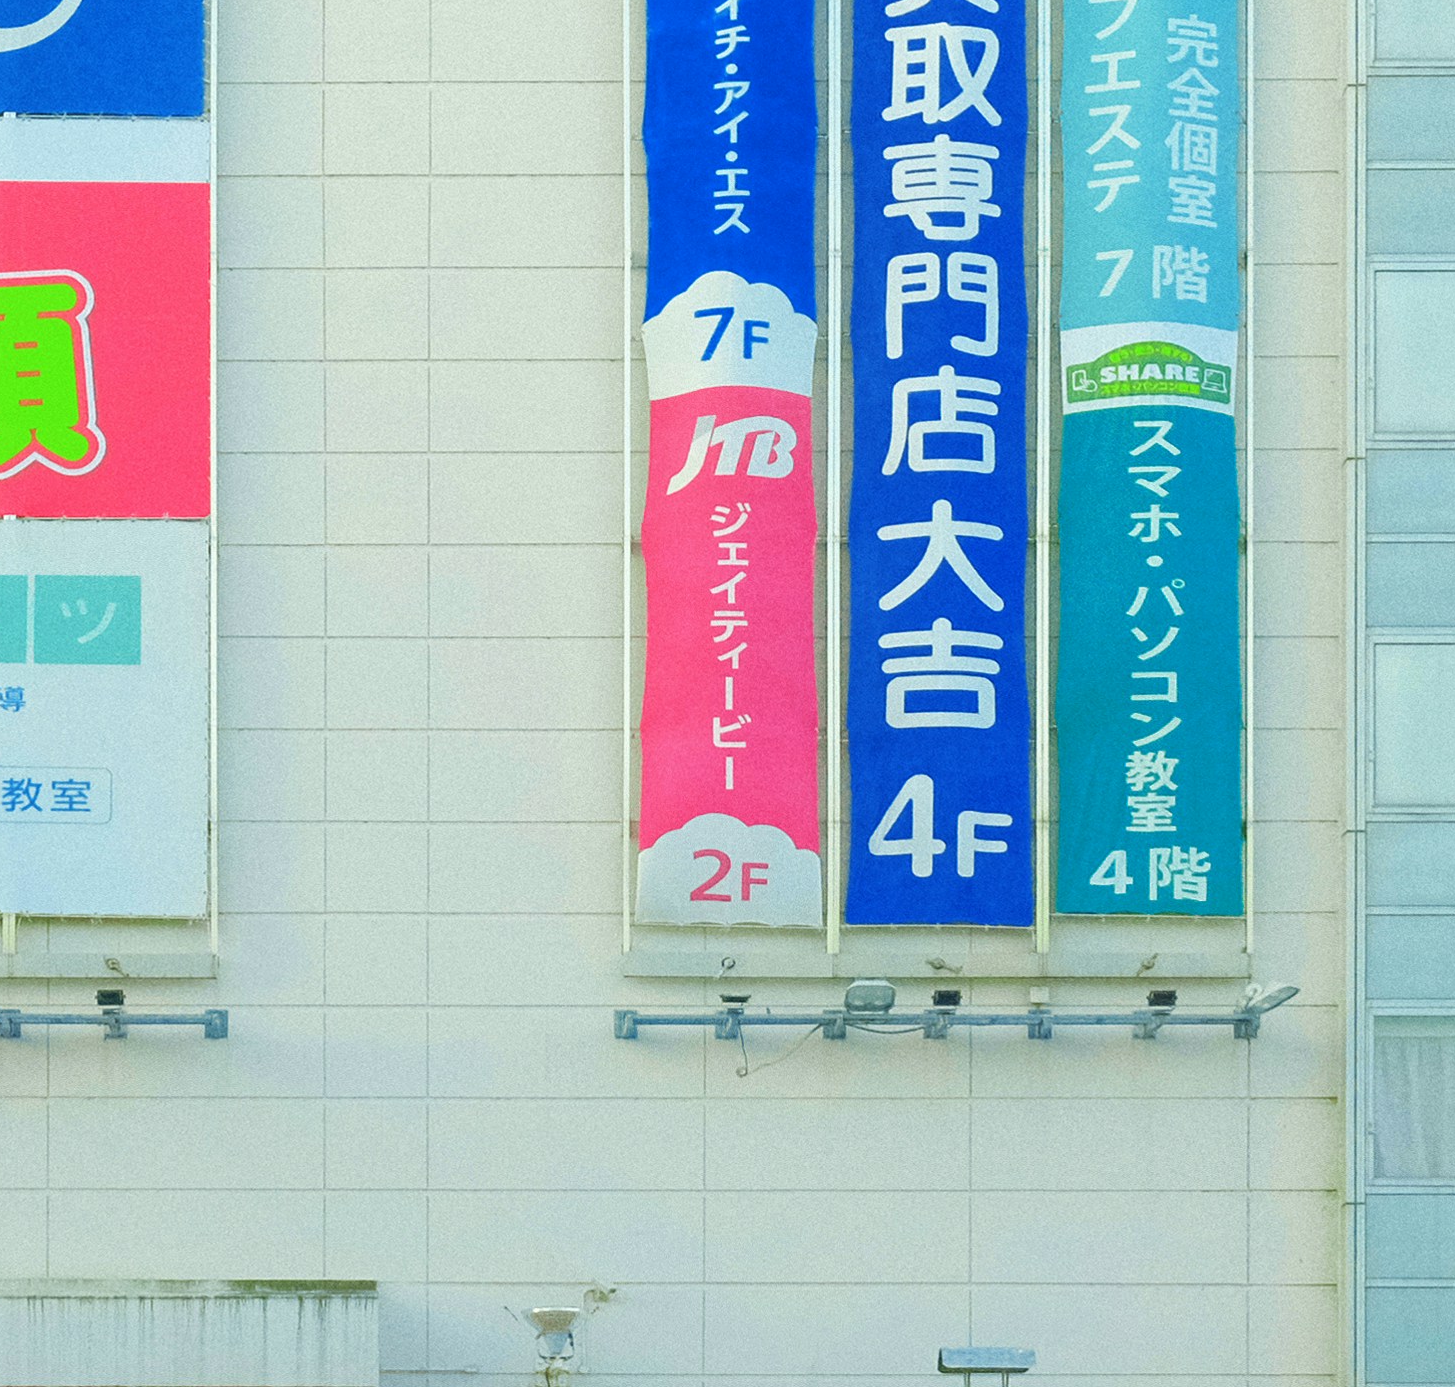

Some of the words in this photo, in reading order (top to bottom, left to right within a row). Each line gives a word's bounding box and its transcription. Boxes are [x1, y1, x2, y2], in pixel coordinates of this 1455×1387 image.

[1094, 244, 1210, 304] 7階
[693, 306, 770, 361] 7F
[1099, 363, 1200, 383] SHARE
[666, 414, 798, 495] JTB
[709, 502, 751, 790] ジェイティービー
[1125, 418, 1185, 833] スマホ・パソコン教室
[868, 773, 1014, 878] 4F
[689, 848, 770, 902] 2F
[1090, 845, 1212, 903] 4階
